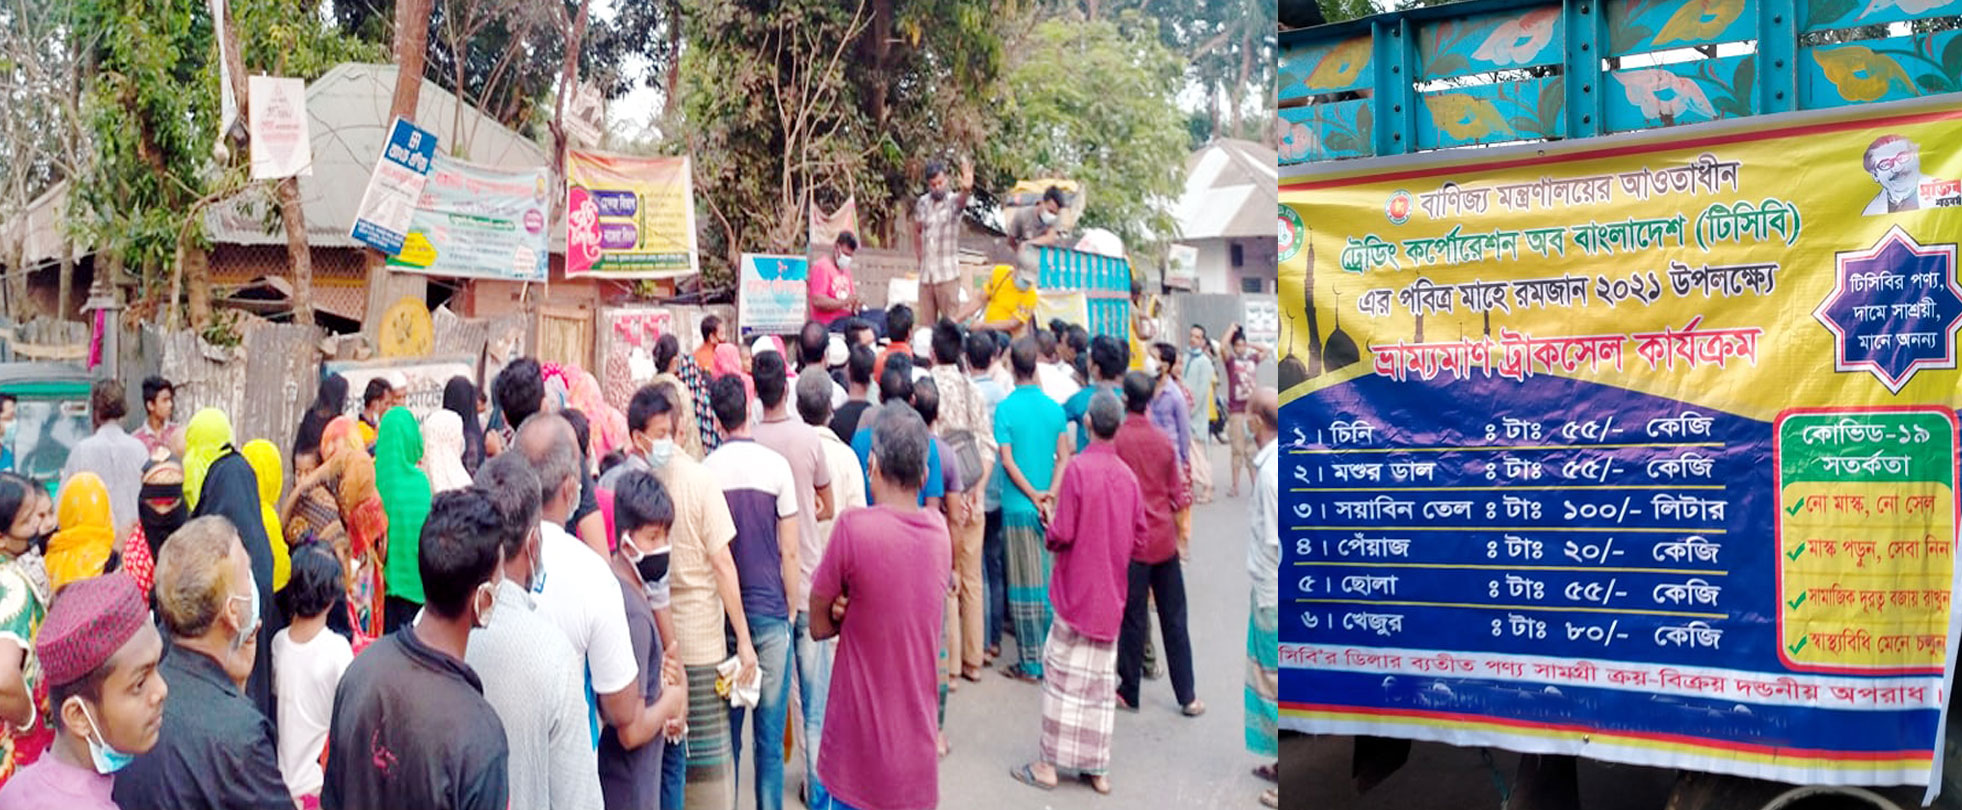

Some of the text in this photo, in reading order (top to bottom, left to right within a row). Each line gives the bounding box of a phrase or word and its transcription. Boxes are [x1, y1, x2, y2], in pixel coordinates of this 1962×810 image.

[1421, 155, 1740, 218] বাণিজ্য মন্ত্রণালয়ের আওতাধীন
[1341, 199, 1800, 273] ট্রেডিং কর্পোরেশন অব বাংলাদেশ (টিসিবি)
[1359, 261, 1778, 315] এর পবিত্র মাহে রমজান ২০২১ উপলক্ষ্যে
[1850, 271, 1945, 293] টিসিবির পণ্য,
[1853, 297, 1941, 322] দামে সাশ্রয়ী,
[1371, 316, 1762, 381] ভ্রাম্যমাণ ট্রাকসেল কার্যক্রম
[1858, 332, 1938, 350] মানে অনন্য
[1329, 421, 1375, 444] চিনি
[1646, 411, 1715, 437] কেজি
[1802, 418, 1930, 445] কোভিড-১৯
[1332, 463, 1383, 482] মশুর
[1389, 461, 1437, 481] ডাল
[1647, 452, 1715, 478] কেজি
[1821, 449, 1912, 476] সতর্কতা
[1334, 495, 1415, 520] সয়াবিন
[1423, 501, 1474, 519] তেল
[1650, 493, 1728, 521] লিটার
[1806, 494, 1936, 518] নো মাস্ক, নো সেল
[1338, 532, 1411, 557] পেঁয়াজ
[1653, 535, 1722, 563] কেজি
[1807, 538, 1837, 558] মাস্ক
[1888, 540, 1919, 559] সেবা
[1925, 534, 1950, 559] নিন
[1341, 574, 1399, 596] ছোলা
[1653, 578, 1722, 606] কেজি
[1808, 583, 1951, 613] সামাজিক দূরত্ব বজায় রাখুন
[1343, 611, 1404, 636] খেজুর
[1655, 621, 1723, 649] কেজি
[1878, 634, 1910, 653] মেনে
[1916, 634, 1946, 655] চলুন
[1345, 648, 1401, 669] ডিলার
[1410, 652, 1476, 673] ব্যতীত
[1485, 660, 1526, 677] পণ্য
[1534, 661, 1599, 682] সামগ্রী
[1829, 683, 1927, 703] অপরাধ
